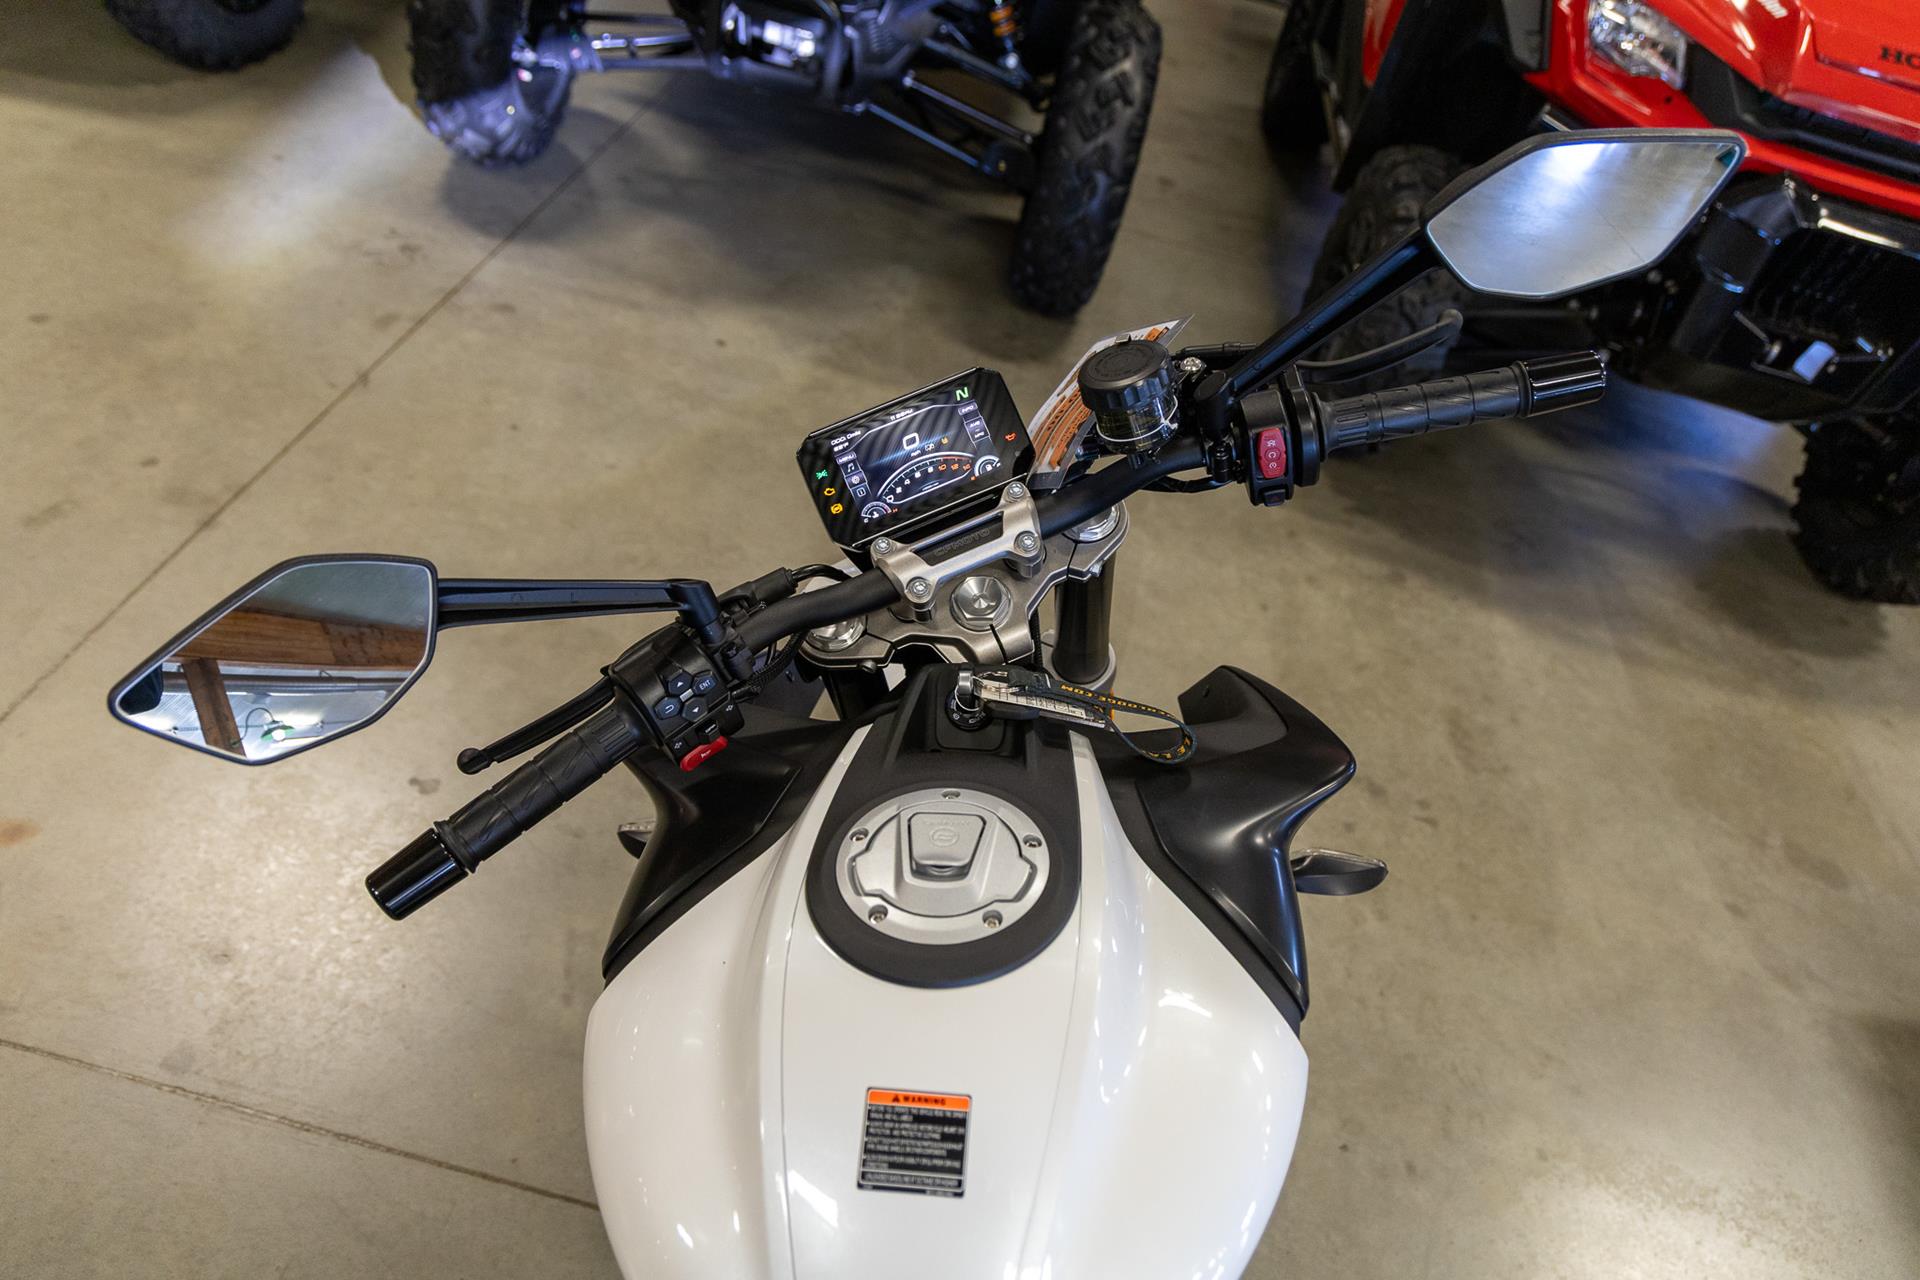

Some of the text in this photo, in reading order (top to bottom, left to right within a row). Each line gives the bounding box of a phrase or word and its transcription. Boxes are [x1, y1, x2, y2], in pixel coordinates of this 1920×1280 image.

[955, 387, 969, 401] N
[699, 679, 712, 691] ENT
[903, 1094, 947, 1106] WARNING
